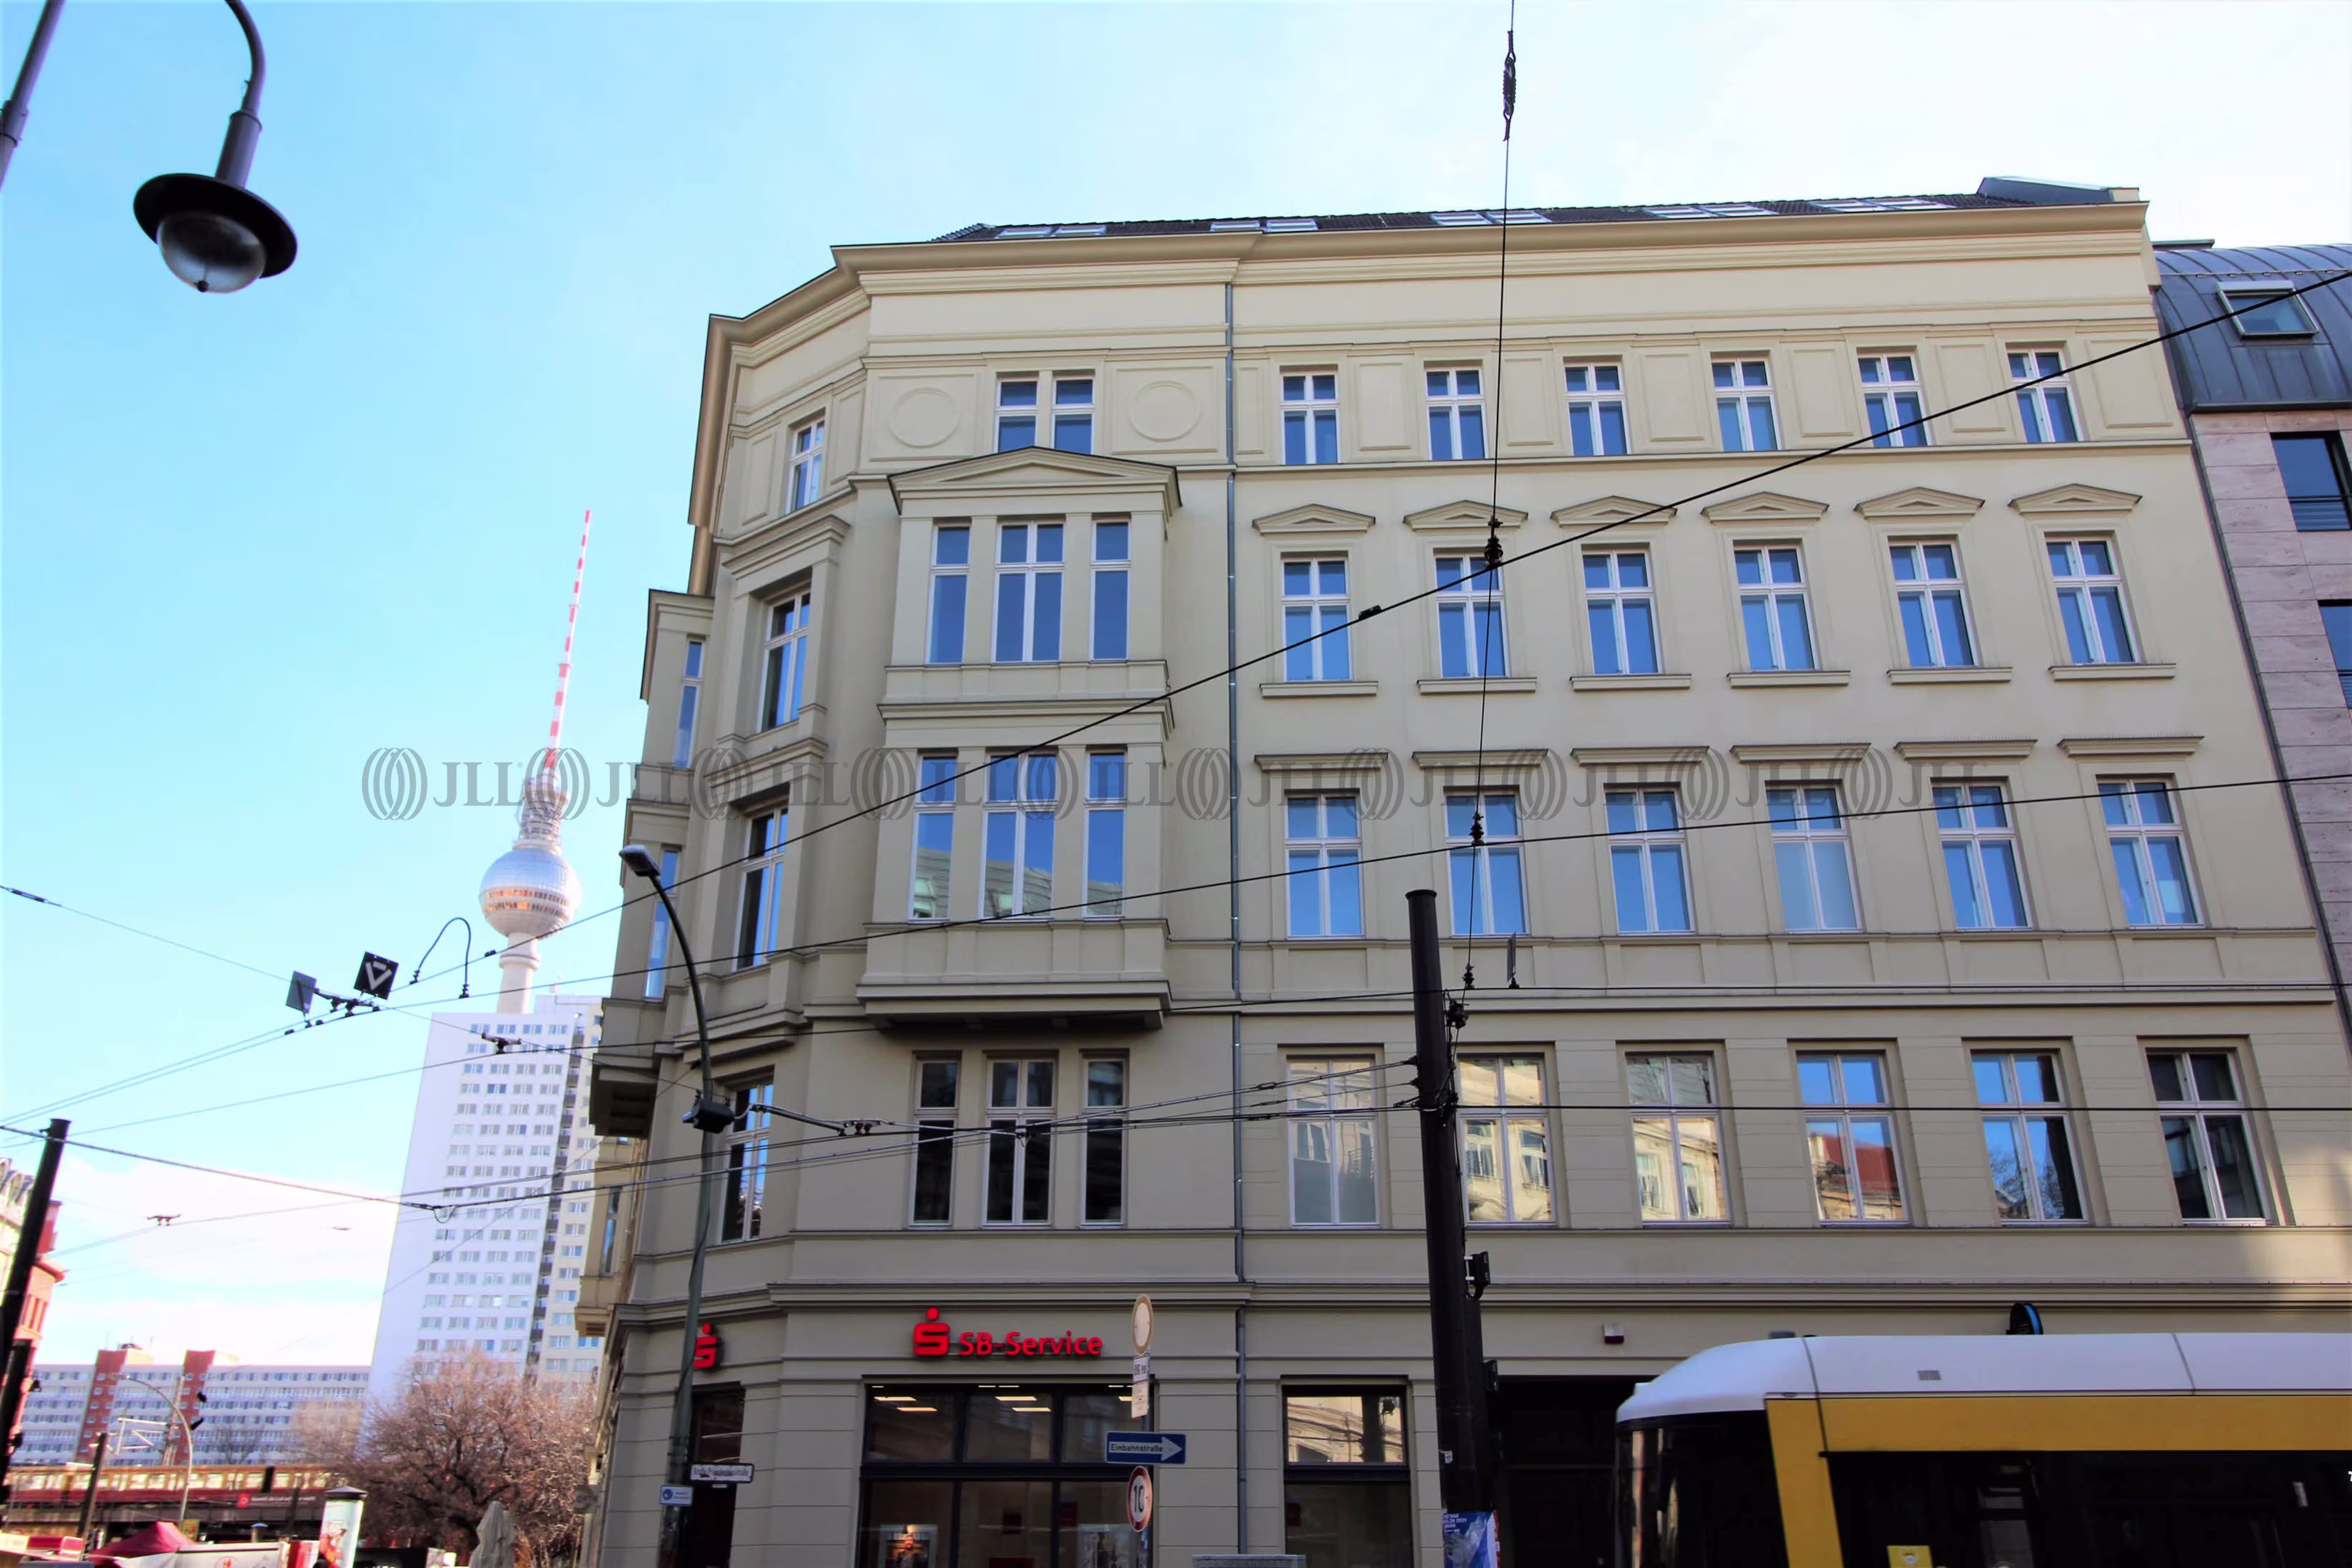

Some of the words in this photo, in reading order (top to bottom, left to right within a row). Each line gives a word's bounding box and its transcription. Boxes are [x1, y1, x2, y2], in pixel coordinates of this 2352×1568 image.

[959, 1330, 1102, 1355] SB-Service
[1110, 1444, 1163, 1452] Einbahnstraße
[1134, 1485, 1145, 1513] 10
